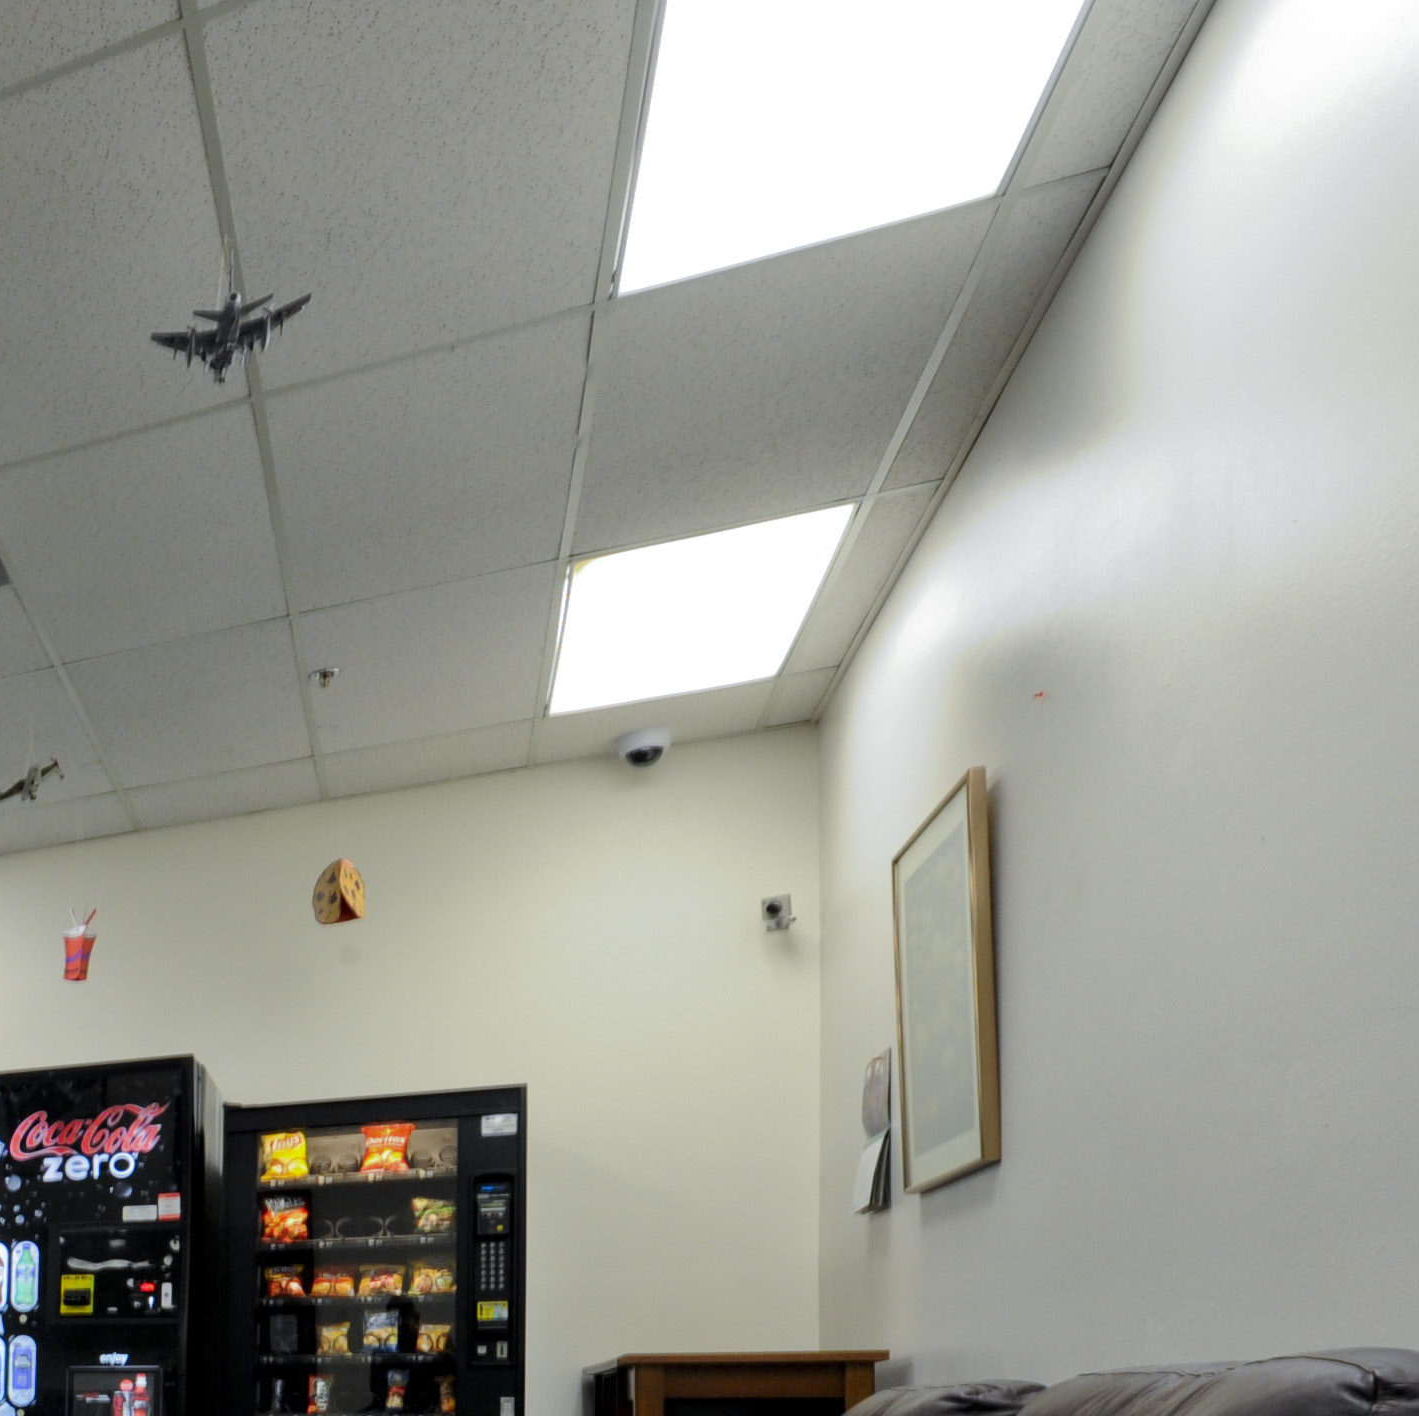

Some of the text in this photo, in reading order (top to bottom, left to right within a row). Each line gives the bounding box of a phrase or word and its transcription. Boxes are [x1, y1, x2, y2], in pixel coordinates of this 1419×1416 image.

[10, 1100, 171, 1162] Coca-Cola
[43, 1152, 136, 1182] zero
[99, 1352, 130, 1366] enjoy
